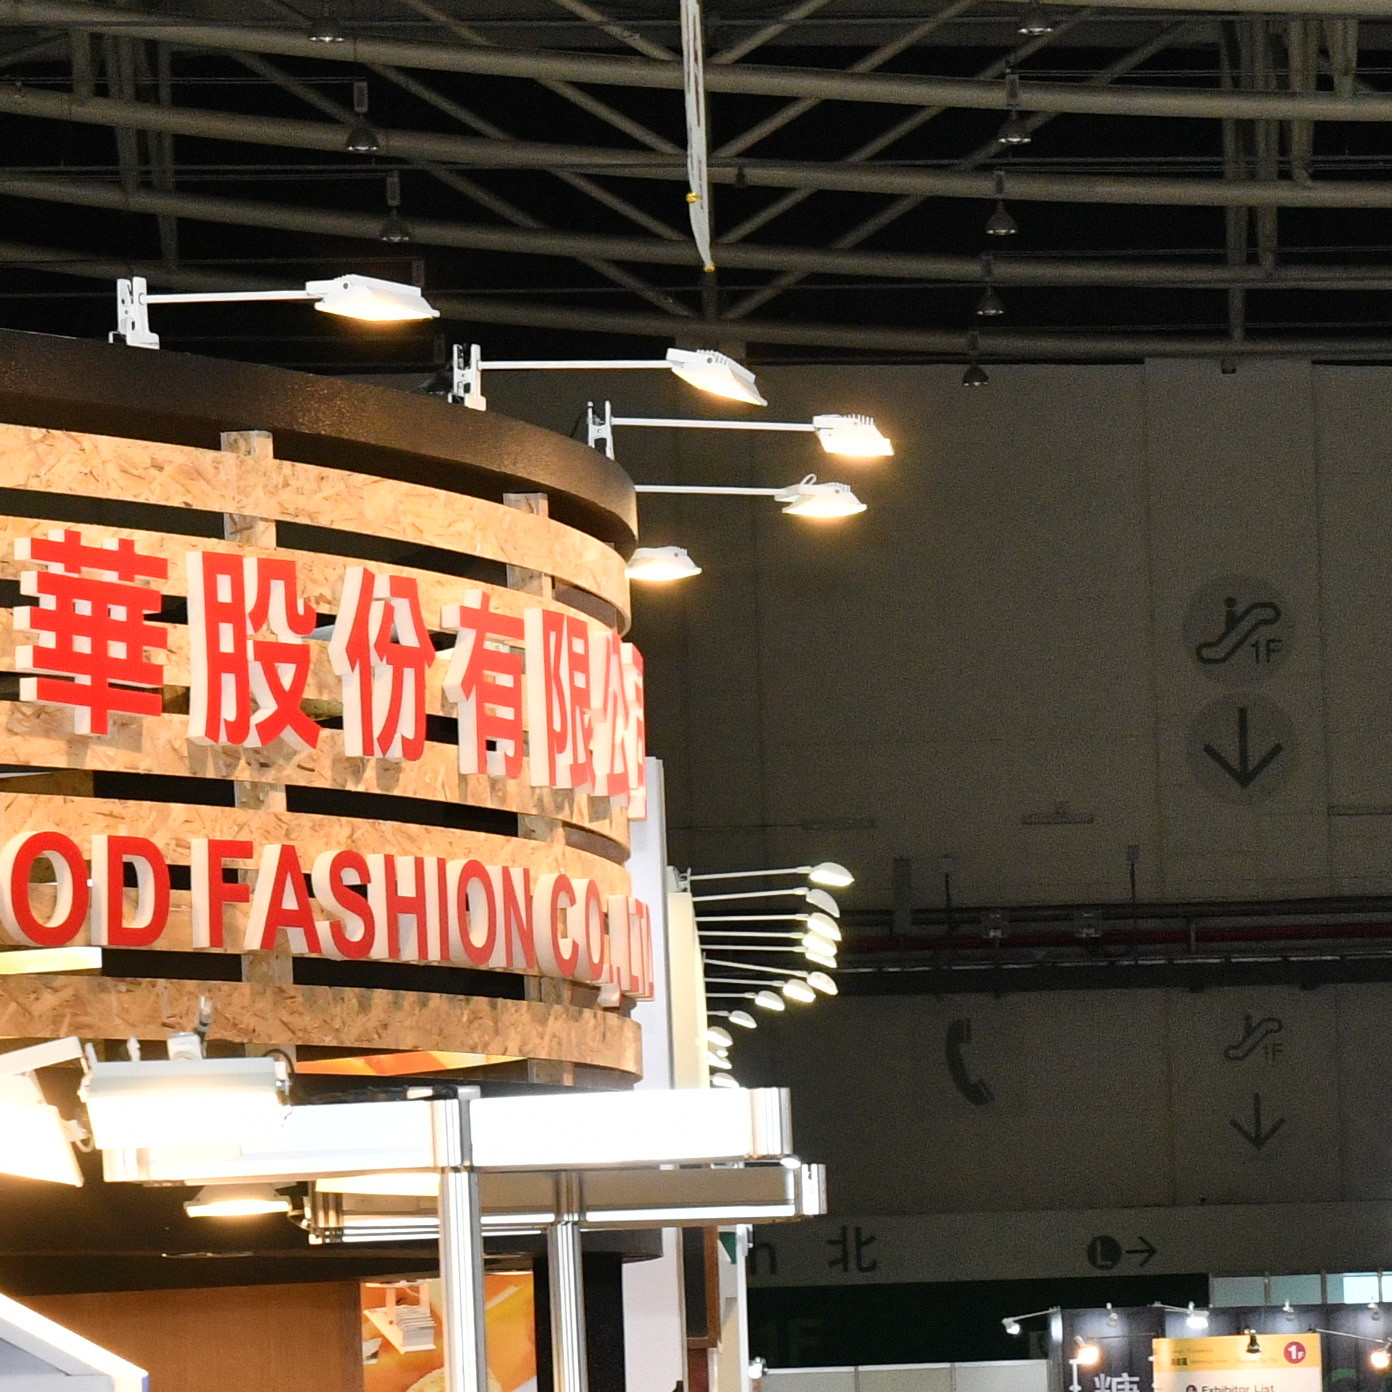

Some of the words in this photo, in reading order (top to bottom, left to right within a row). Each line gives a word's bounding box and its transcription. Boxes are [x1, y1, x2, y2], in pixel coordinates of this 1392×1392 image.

[191, 839, 537, 971] FASHION
[826, 1225, 878, 1273] 北
[1287, 1344, 1305, 1360] 1F
